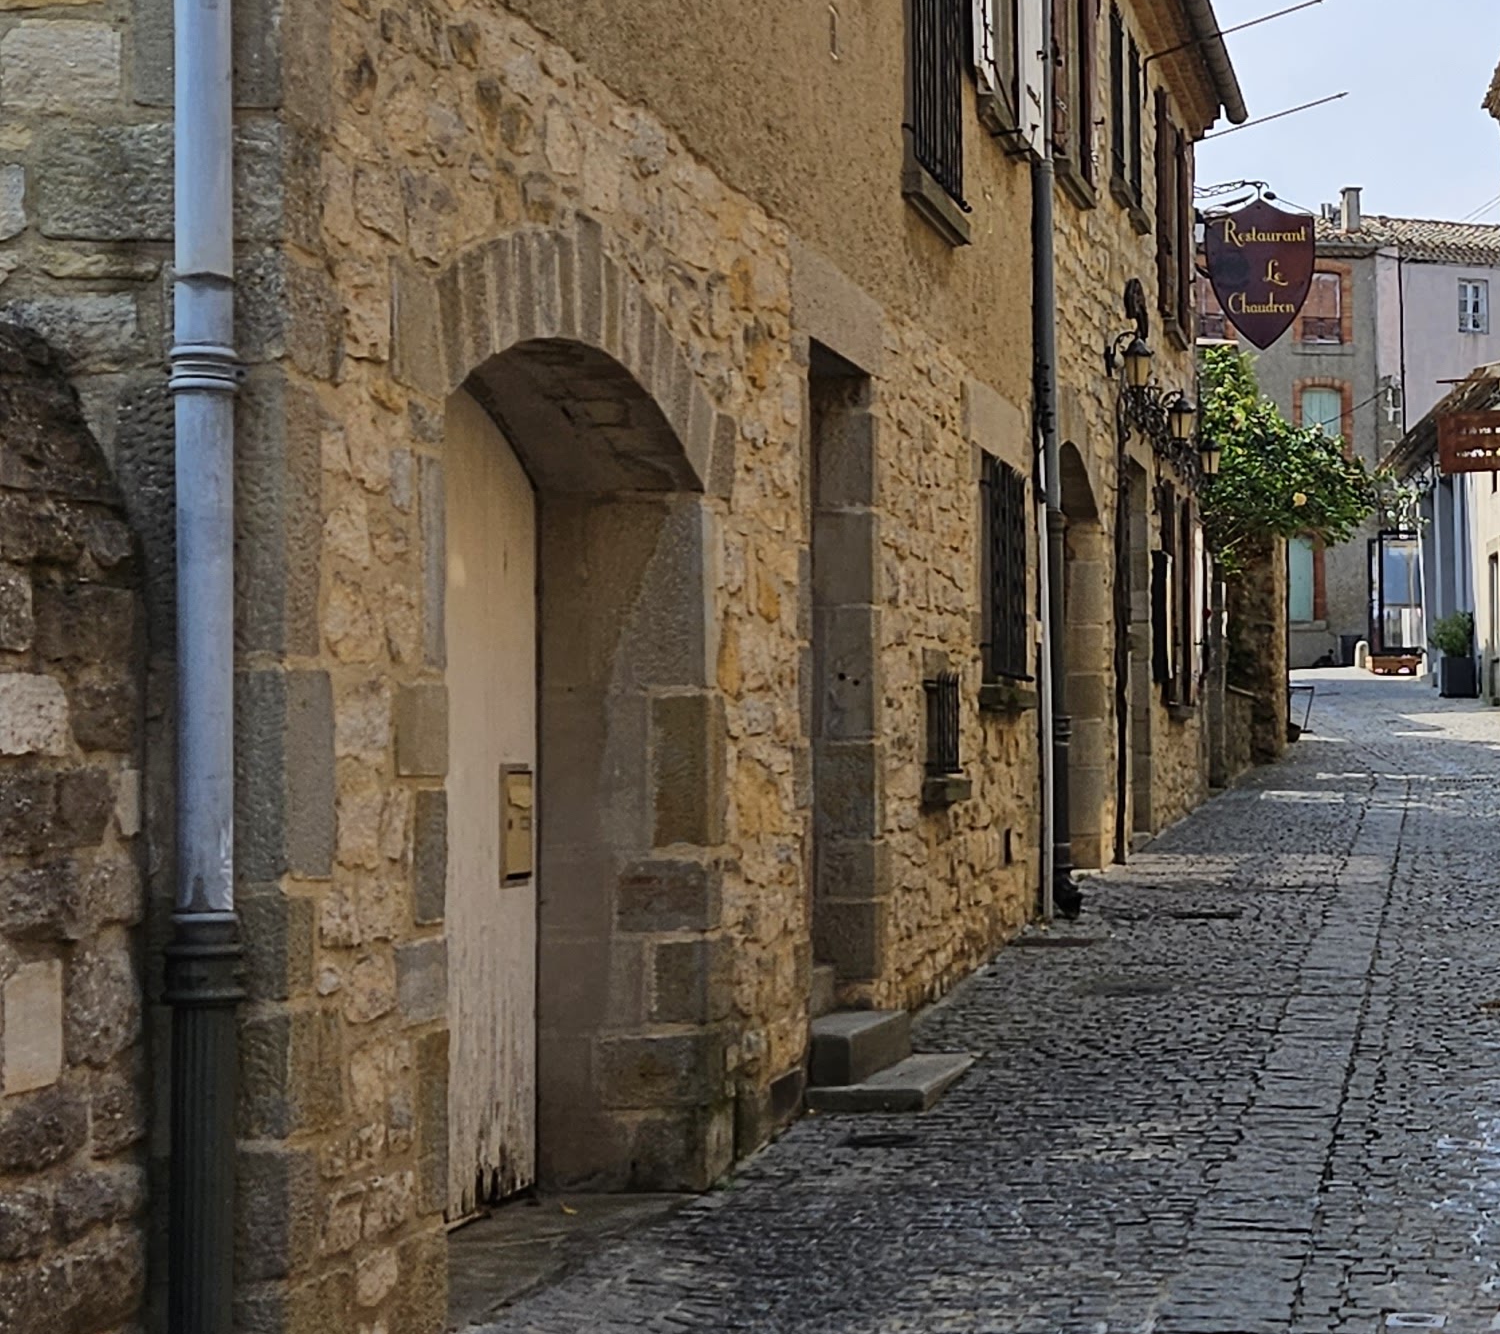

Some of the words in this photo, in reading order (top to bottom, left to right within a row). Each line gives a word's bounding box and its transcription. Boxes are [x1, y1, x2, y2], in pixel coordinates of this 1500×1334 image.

[1224, 218, 1306, 247] Restaurant
[1263, 259, 1288, 286] Le
[1228, 291, 1295, 314] Chaudron
